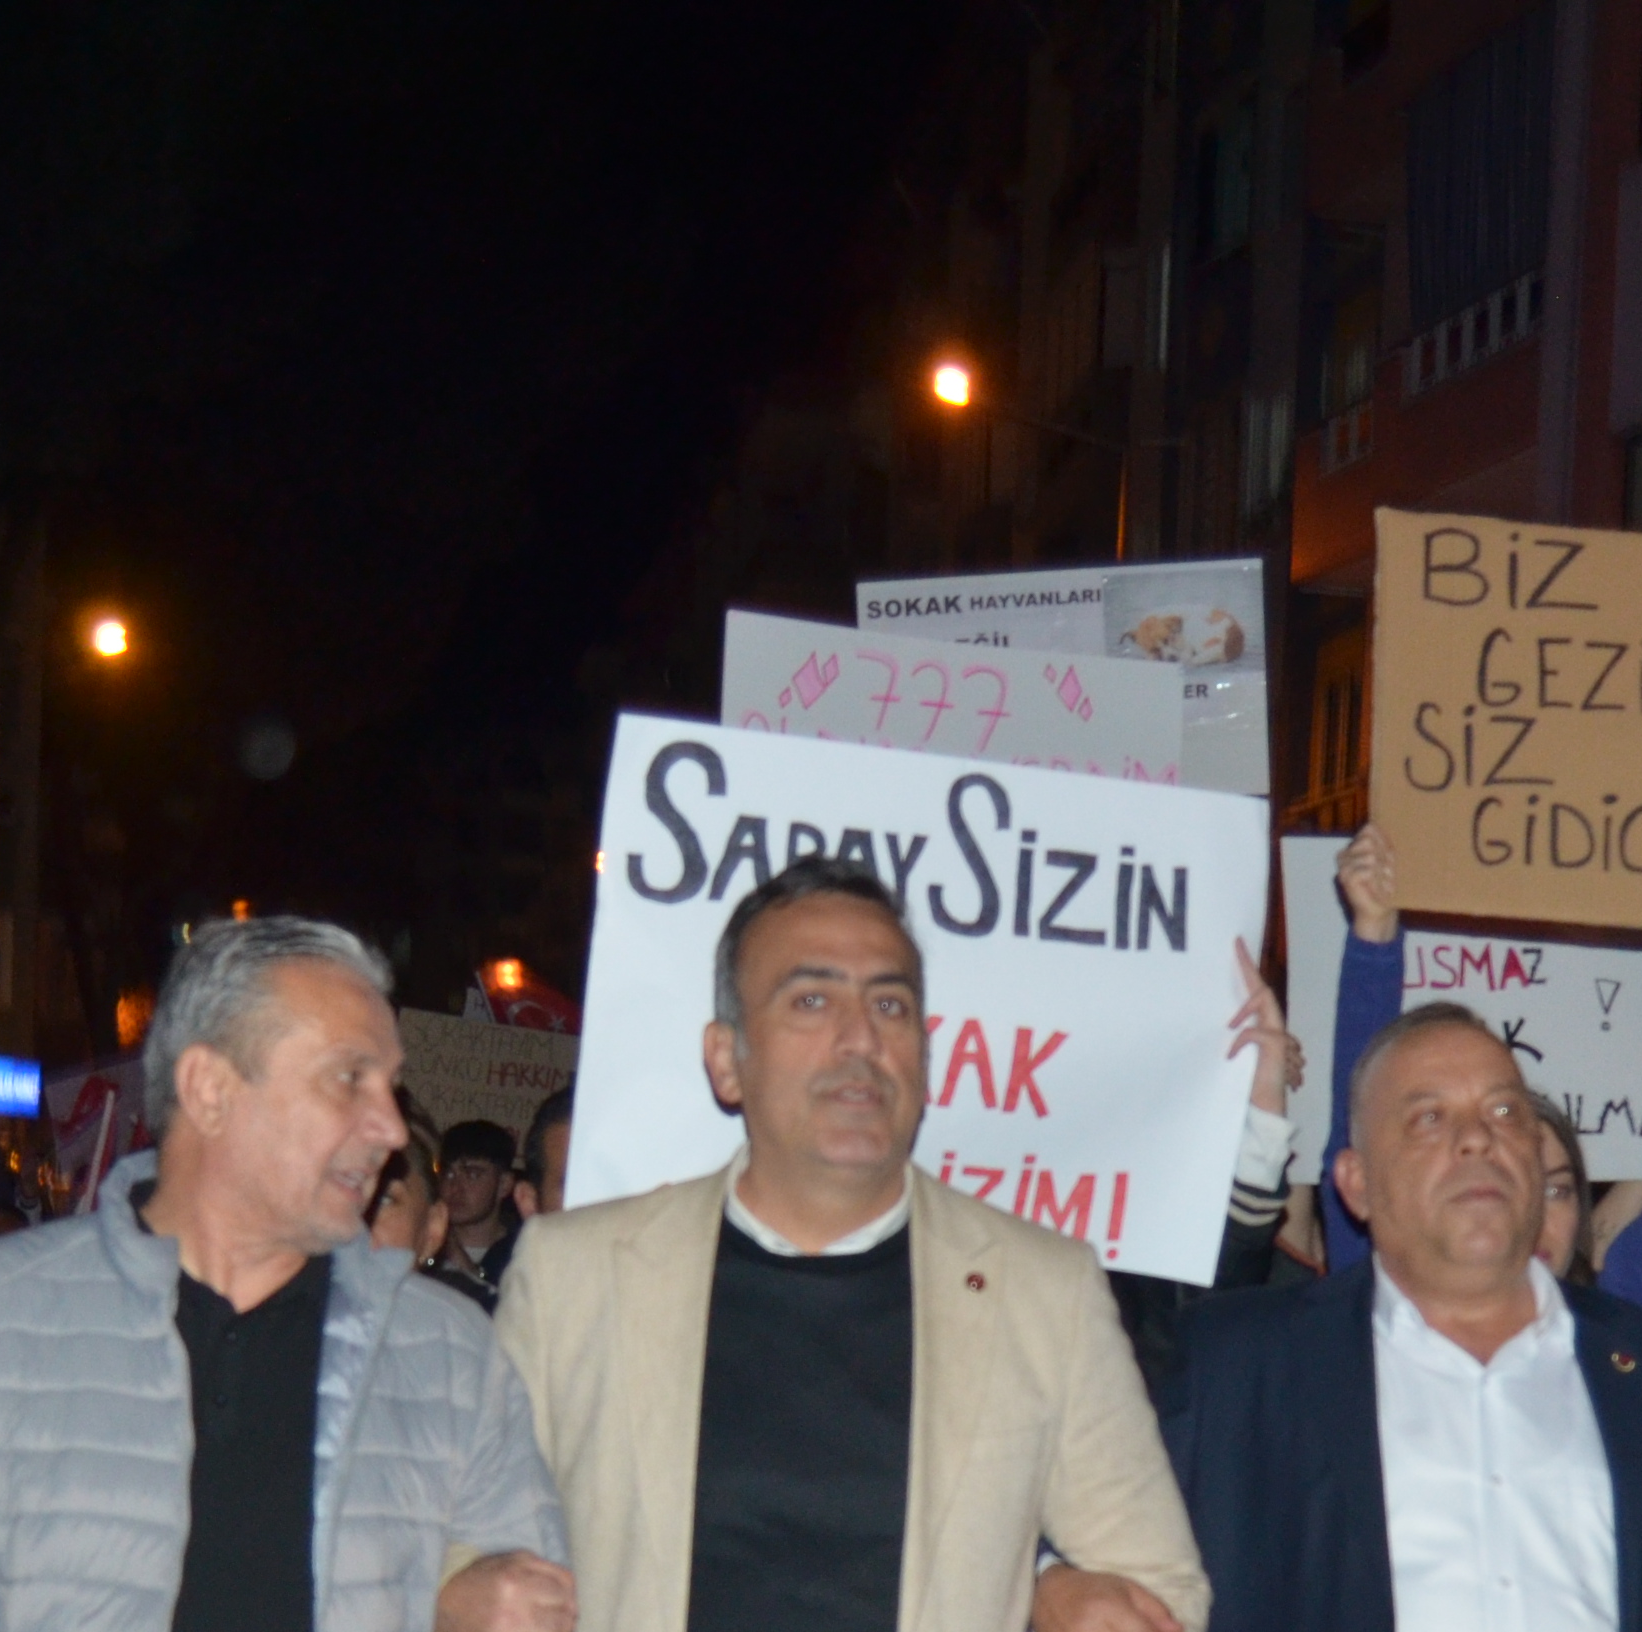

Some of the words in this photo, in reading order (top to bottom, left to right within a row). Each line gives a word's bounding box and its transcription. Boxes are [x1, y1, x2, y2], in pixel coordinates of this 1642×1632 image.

[866, 594, 963, 620] SOKAK
[969, 588, 1103, 612] HAYVANLARI
[855, 651, 1011, 755] 777
[924, 1014, 1068, 1118] AK
